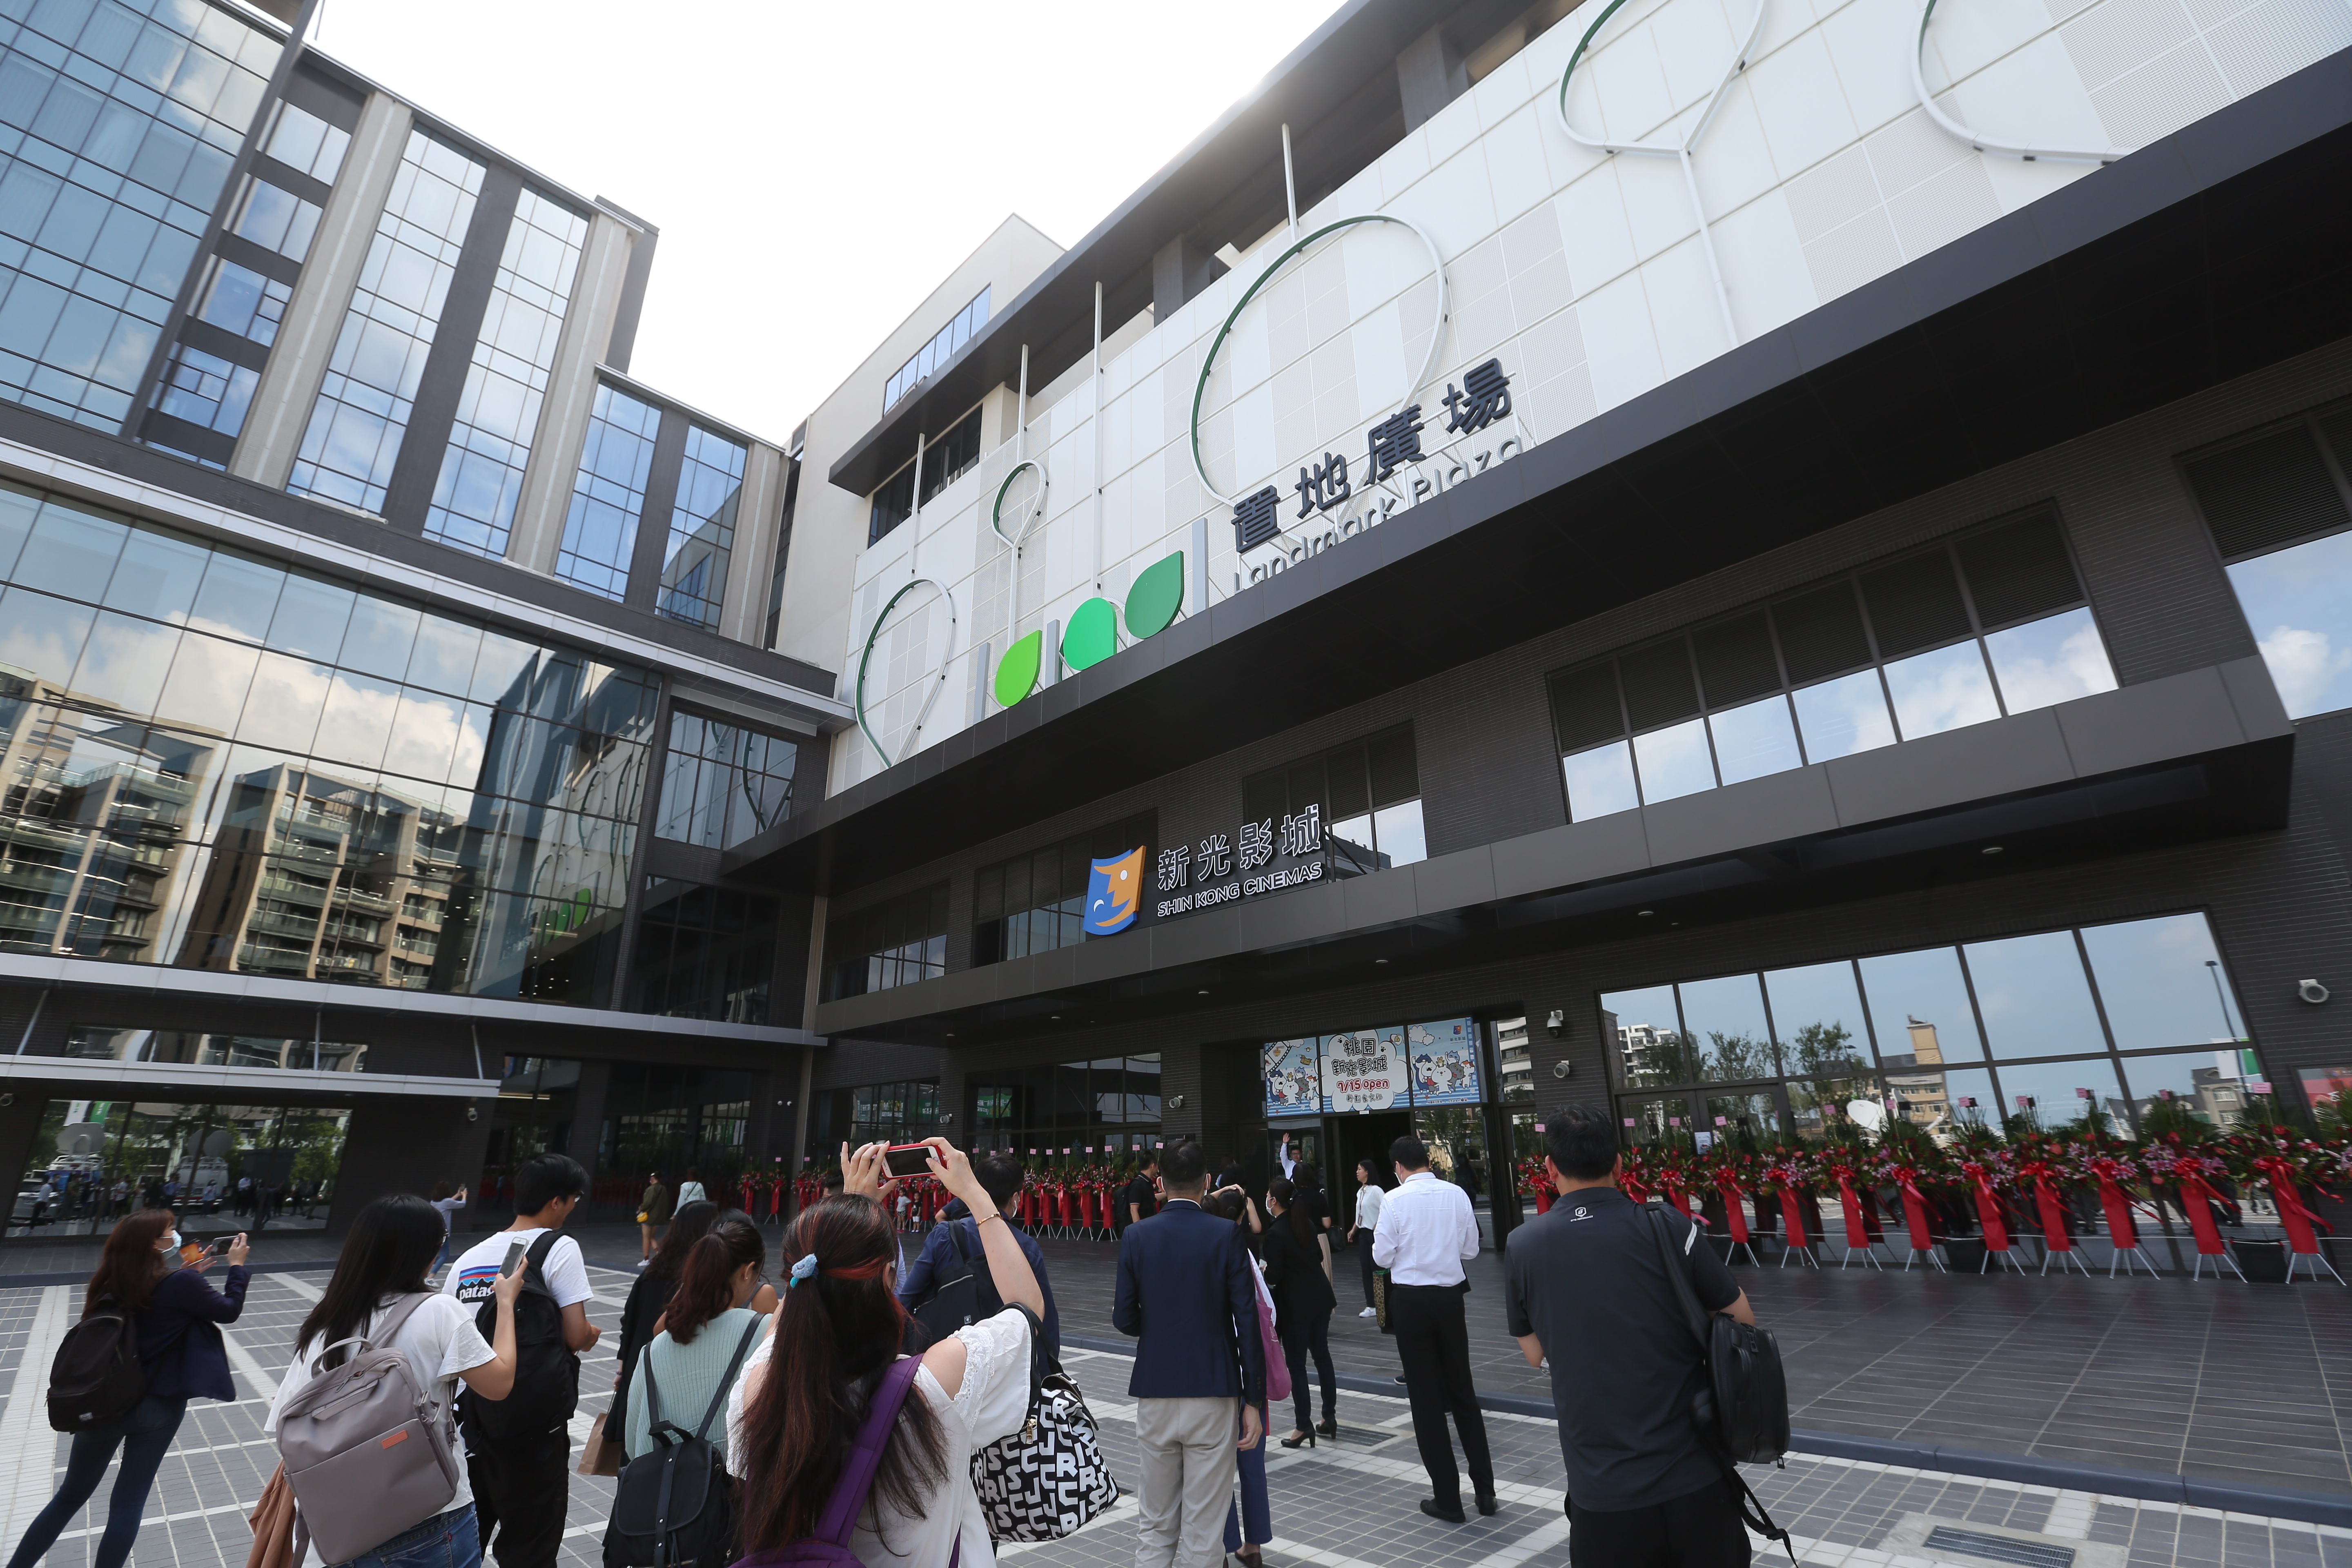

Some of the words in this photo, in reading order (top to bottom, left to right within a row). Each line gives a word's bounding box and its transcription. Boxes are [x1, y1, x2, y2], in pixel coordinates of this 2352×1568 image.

[1232, 358, 1512, 554] 置地廣場
[1234, 497, 1396, 595] Landmark
[1411, 434, 1522, 507] Plaza
[1157, 803, 1322, 891] 新光影城
[1157, 895, 1192, 917] SHIN
[1195, 882, 1240, 909] KONG
[1243, 862, 1322, 895] CINEMAS
[1331, 1055, 1388, 1077] 新光影城
[1343, 1037, 1376, 1057] 桃園
[1336, 1078, 1362, 1093] 7/15
[1362, 1079, 1390, 1092] open
